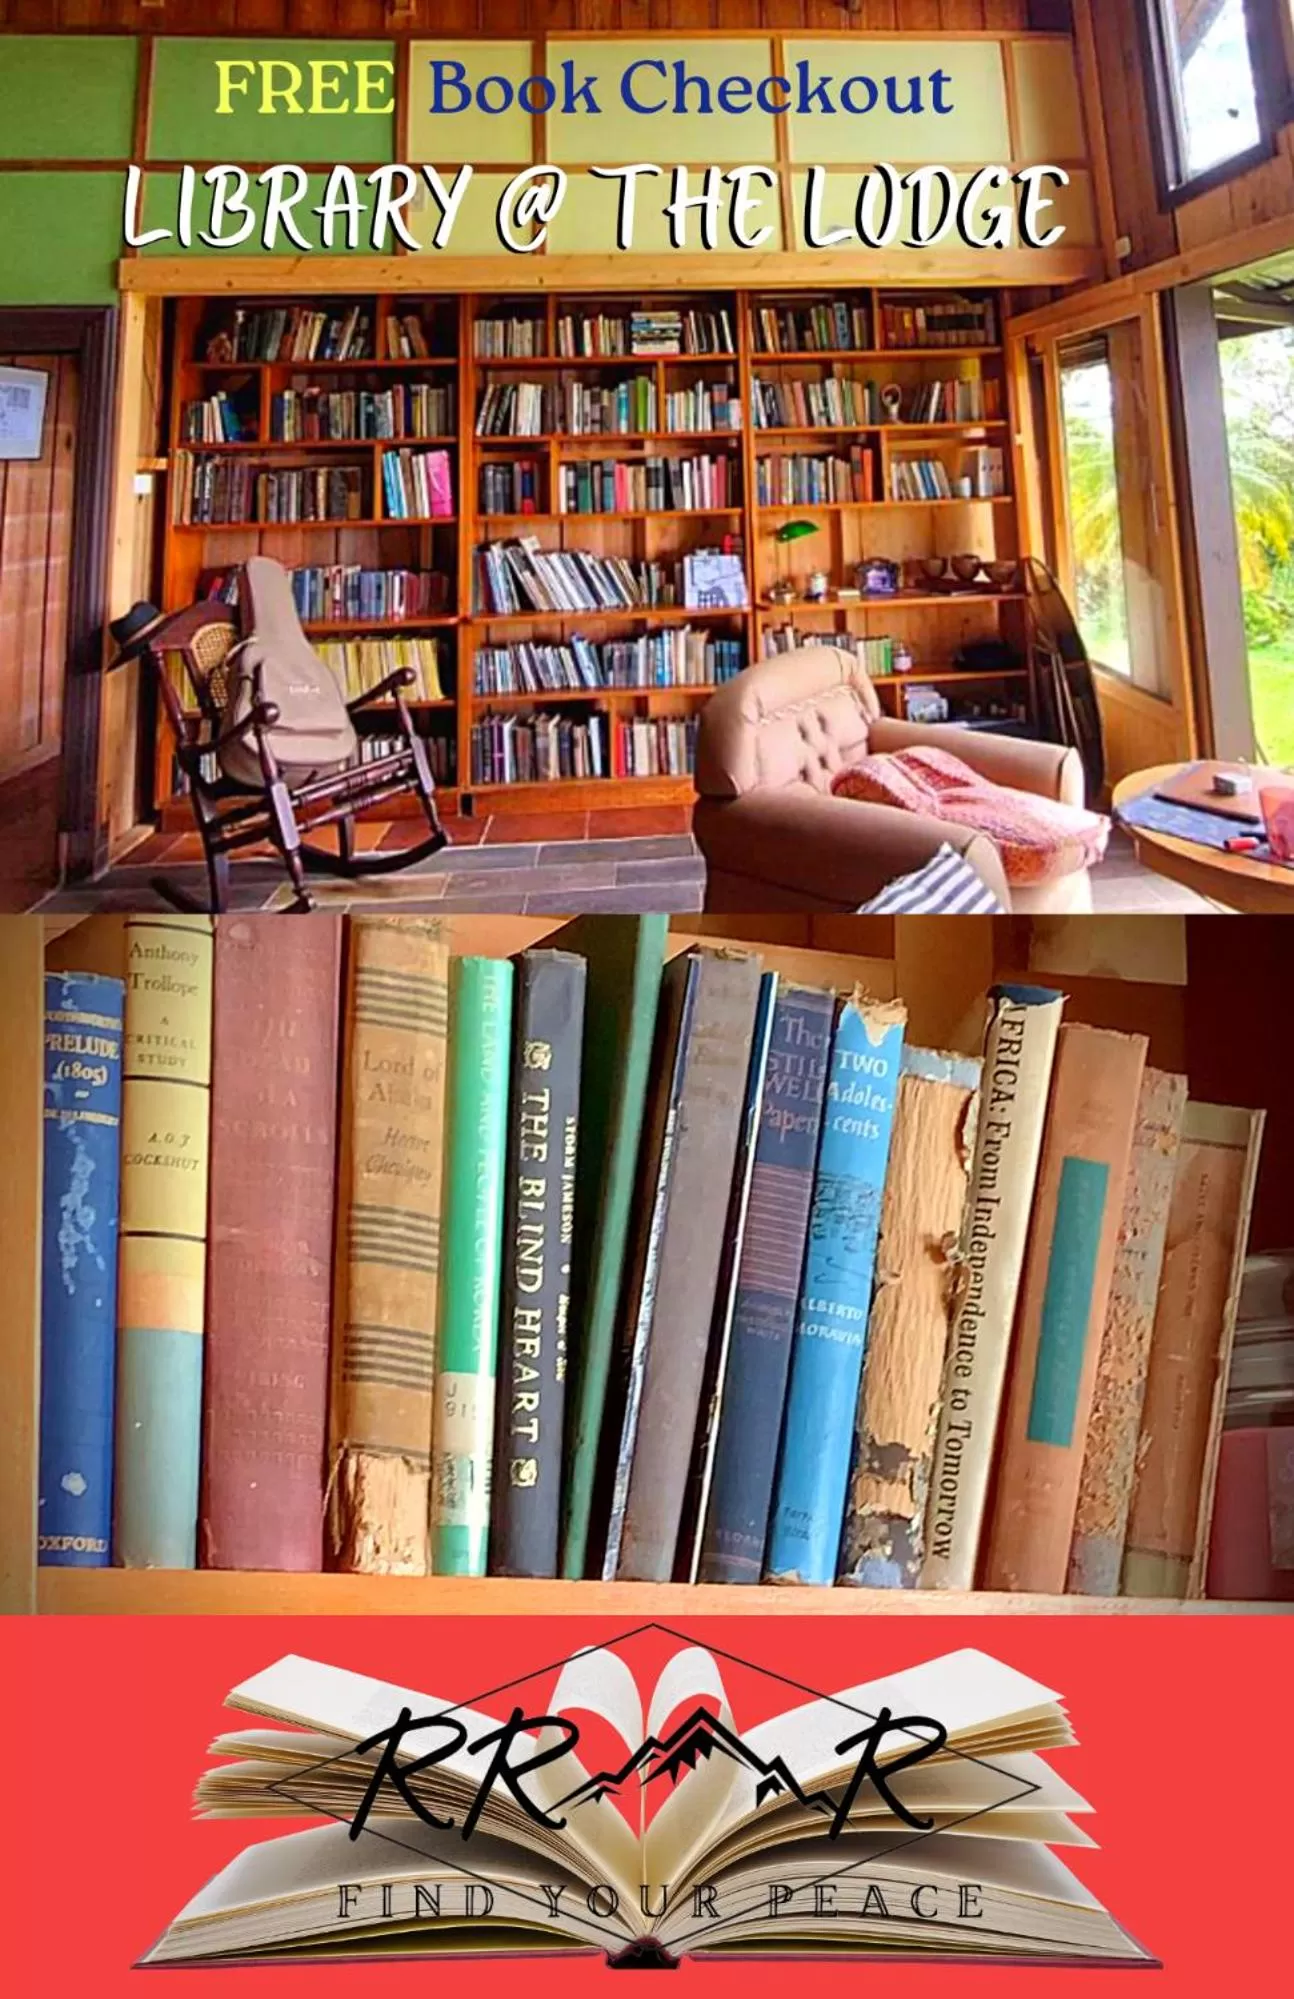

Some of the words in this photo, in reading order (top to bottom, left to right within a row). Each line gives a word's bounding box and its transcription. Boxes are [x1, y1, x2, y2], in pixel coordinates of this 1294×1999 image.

[128, 971, 200, 997] Trollope
[129, 941, 200, 967] Anthony
[363, 1050, 416, 1077] Lord
[839, 1051, 889, 1078] TWO
[519, 1088, 550, 1163] THE
[564, 1116, 578, 1168] STORM
[832, 1115, 881, 1140] cents
[978, 1120, 1012, 1192] From
[516, 1176, 547, 1294] BLIND
[559, 1174, 576, 1244] JAMESON
[954, 1197, 1003, 1378] Independence
[510, 1306, 543, 1444] HEART
[950, 1388, 973, 1412] to
[932, 1419, 973, 1561] Tomorrow
